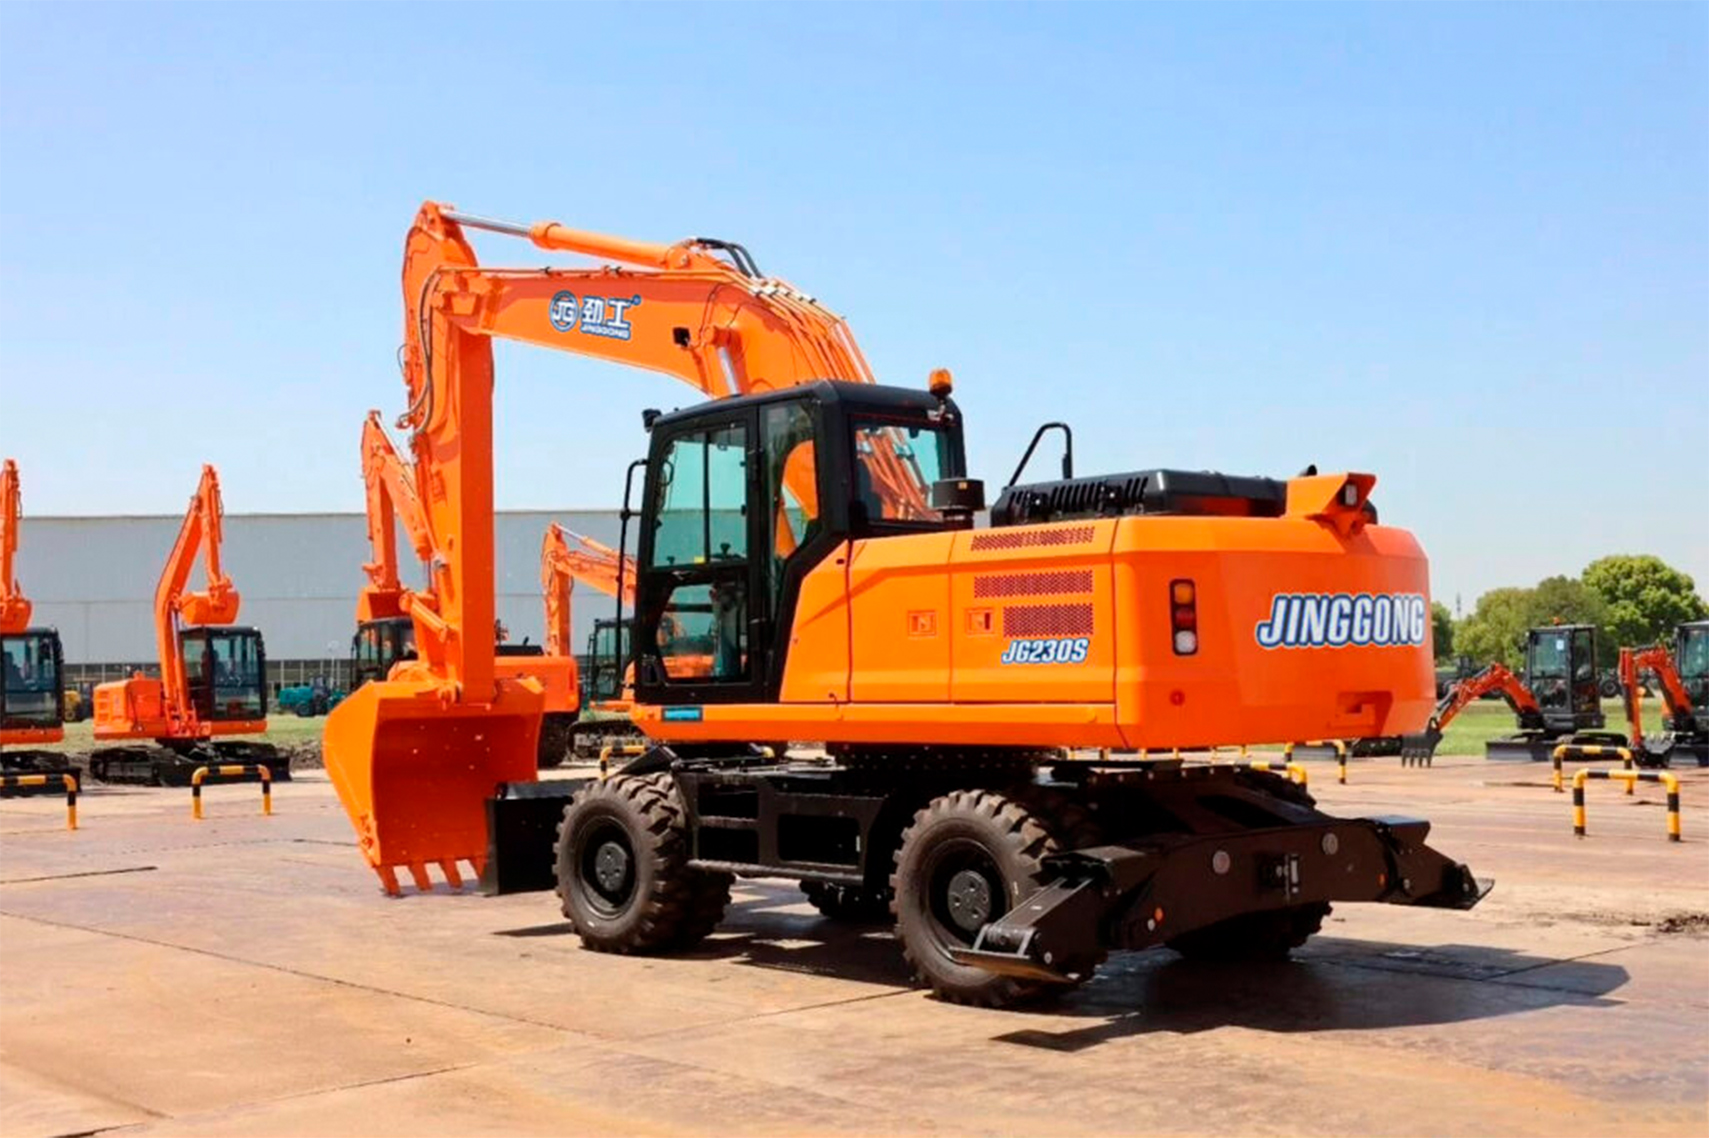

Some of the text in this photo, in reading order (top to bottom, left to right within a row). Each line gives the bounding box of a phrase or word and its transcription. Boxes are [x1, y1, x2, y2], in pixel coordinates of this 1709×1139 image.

[552, 300, 576, 322] JG
[581, 296, 631, 328] 劲工
[1256, 594, 1424, 647] JINGGONG
[1001, 638, 1089, 664] JG230S
